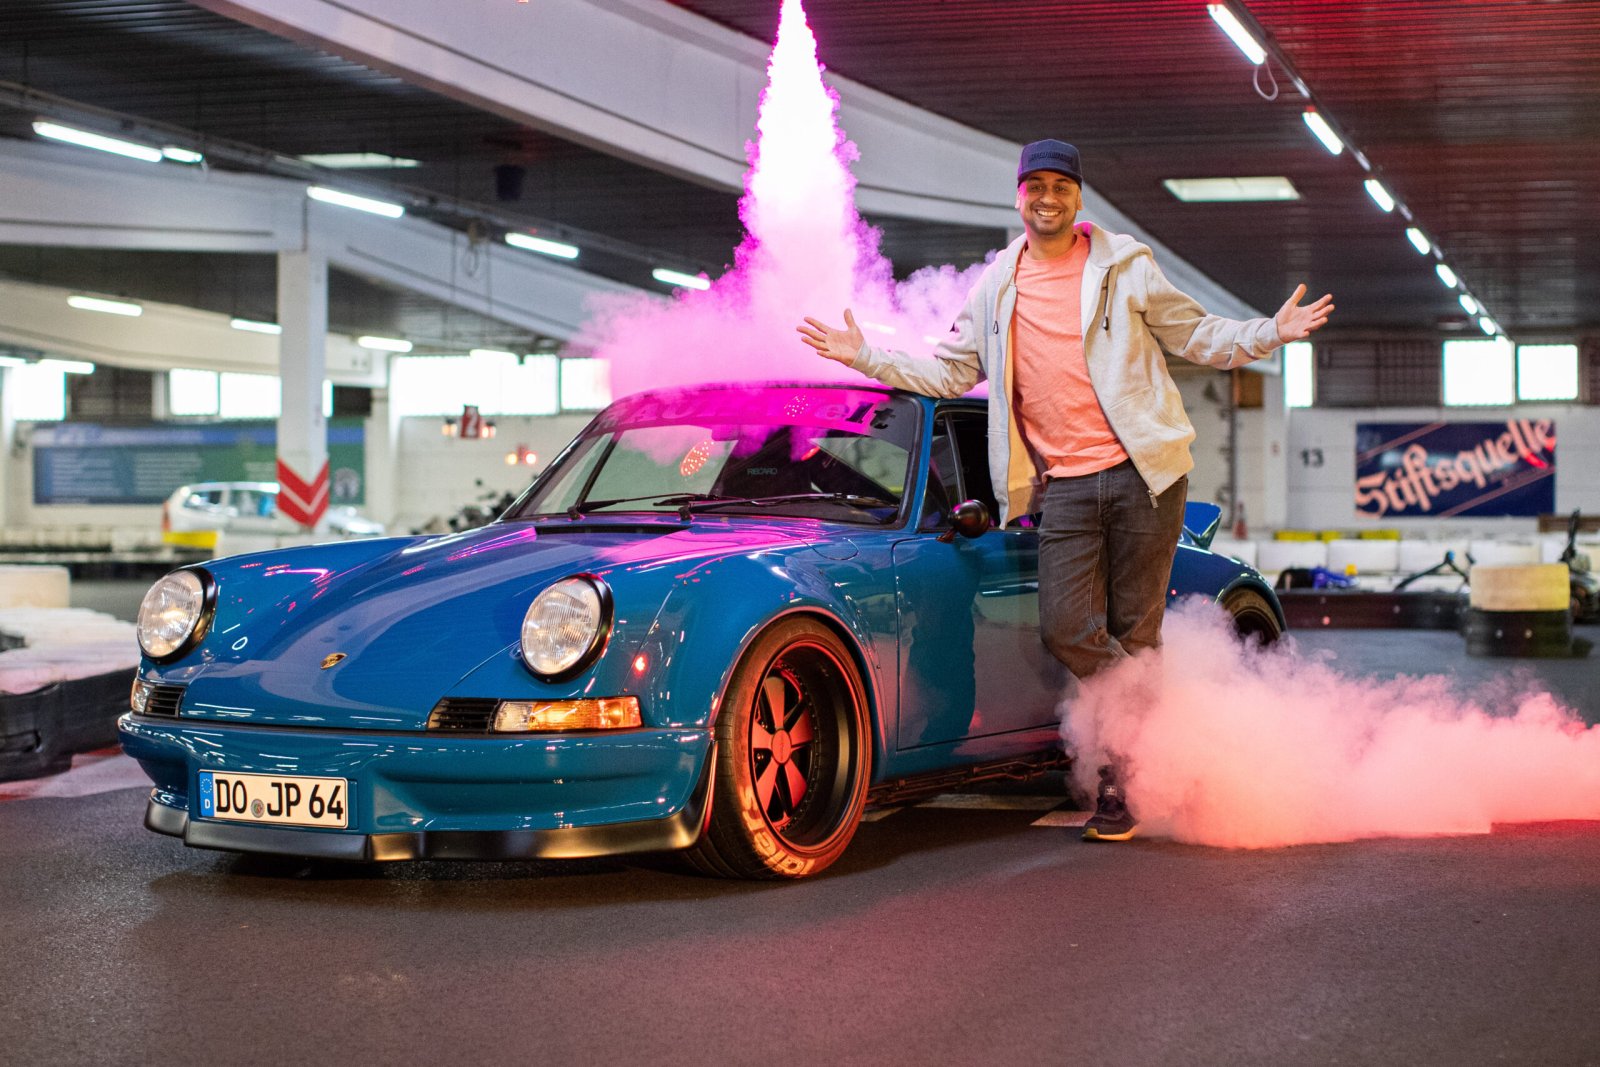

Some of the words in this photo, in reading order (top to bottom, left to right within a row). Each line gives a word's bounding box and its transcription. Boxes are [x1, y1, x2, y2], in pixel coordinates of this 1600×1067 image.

[1300, 448, 1324, 468] 13
[1355, 419, 1556, 517] Stiftsquelle
[204, 798, 211, 810] D
[215, 779, 247, 814] DO
[267, 782, 301, 817] JP
[309, 784, 343, 820] 64
